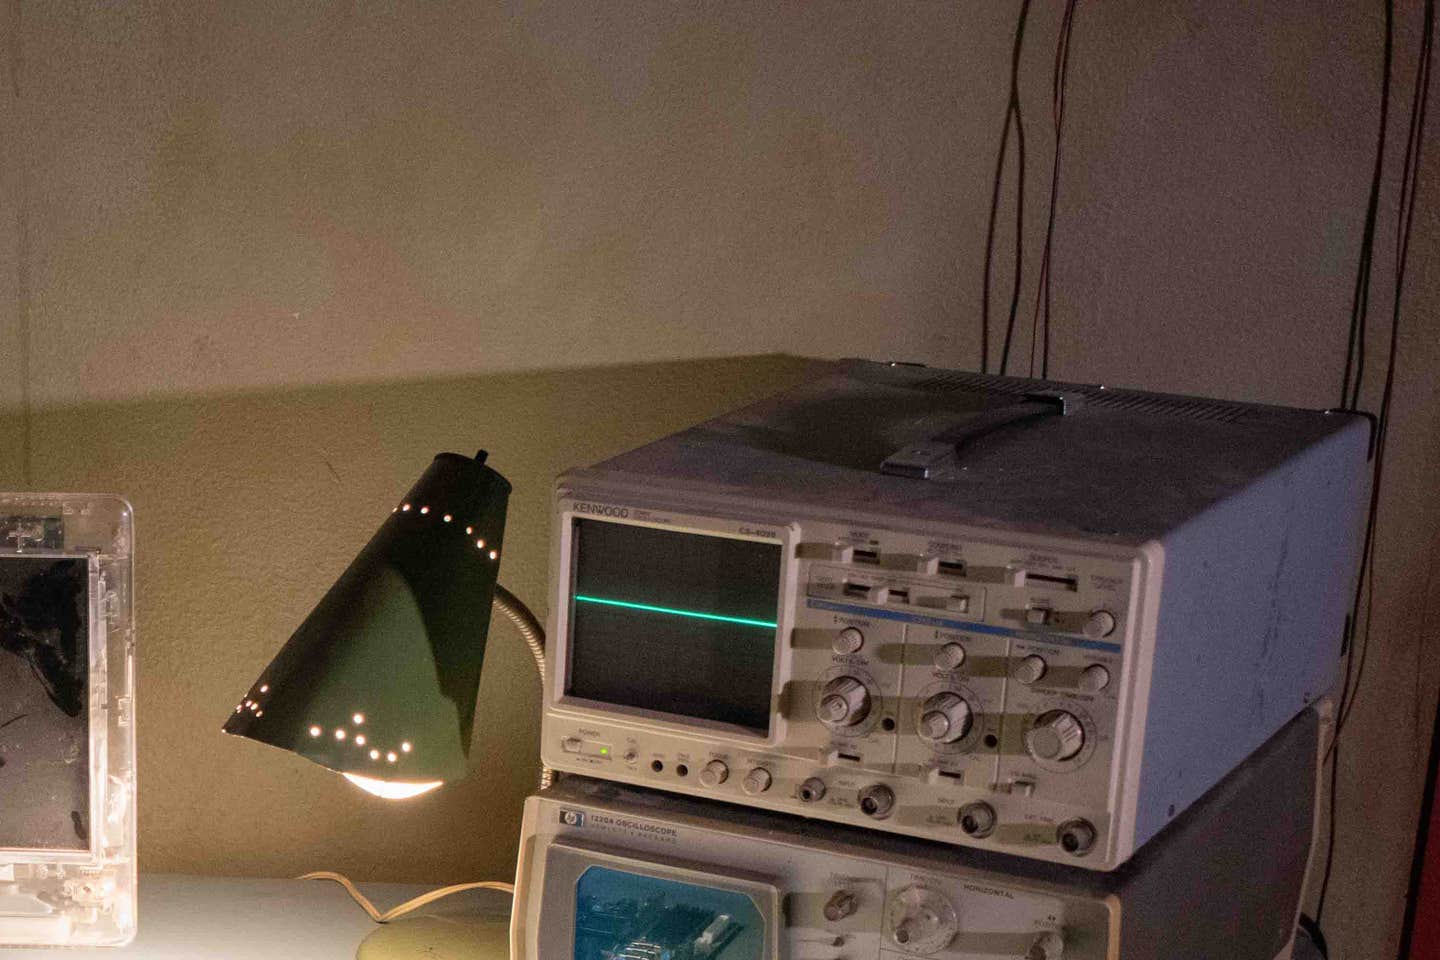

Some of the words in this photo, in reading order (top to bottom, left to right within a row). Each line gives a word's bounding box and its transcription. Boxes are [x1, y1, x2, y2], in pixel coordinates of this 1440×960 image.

[572, 502, 629, 518] KENWOOD
[591, 815, 613, 825] 1220A
[615, 819, 677, 837] OSCILLOSCOPE
[964, 884, 1015, 900] HORIZONTAL
